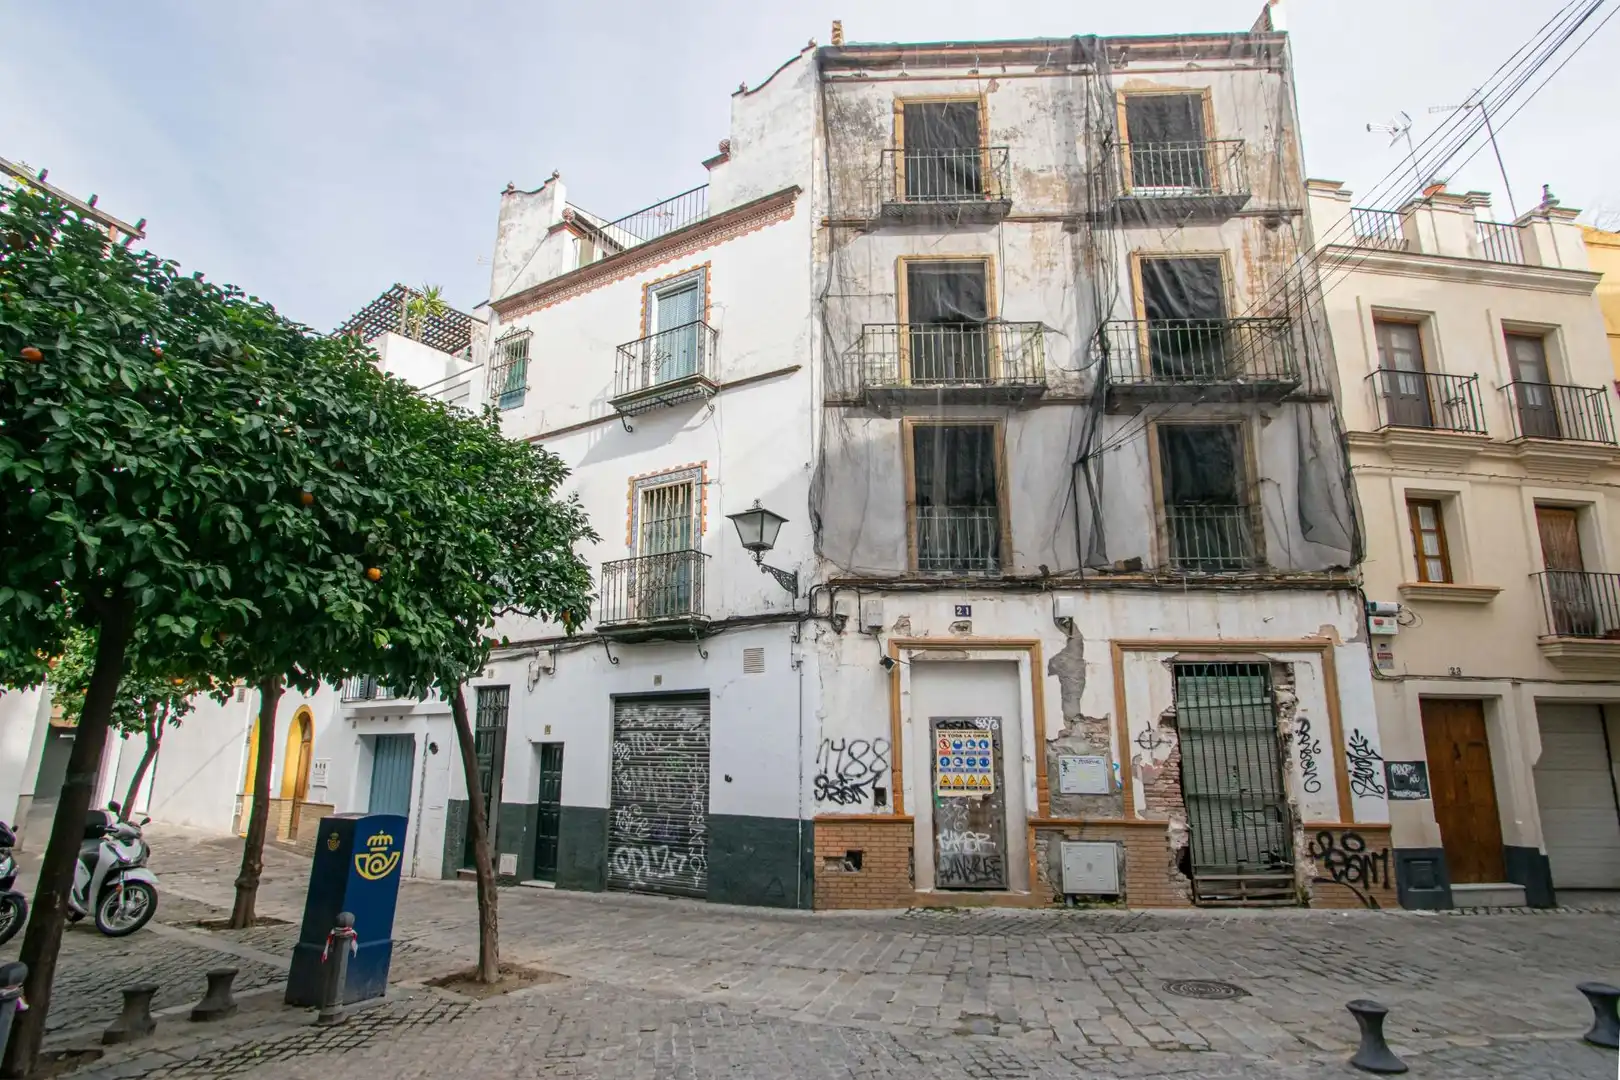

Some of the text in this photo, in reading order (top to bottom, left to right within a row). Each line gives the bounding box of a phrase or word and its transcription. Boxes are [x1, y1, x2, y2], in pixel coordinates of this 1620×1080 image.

[956, 606, 969, 616] 21
[1450, 666, 1462, 676] 23
[816, 737, 891, 777] 1488
